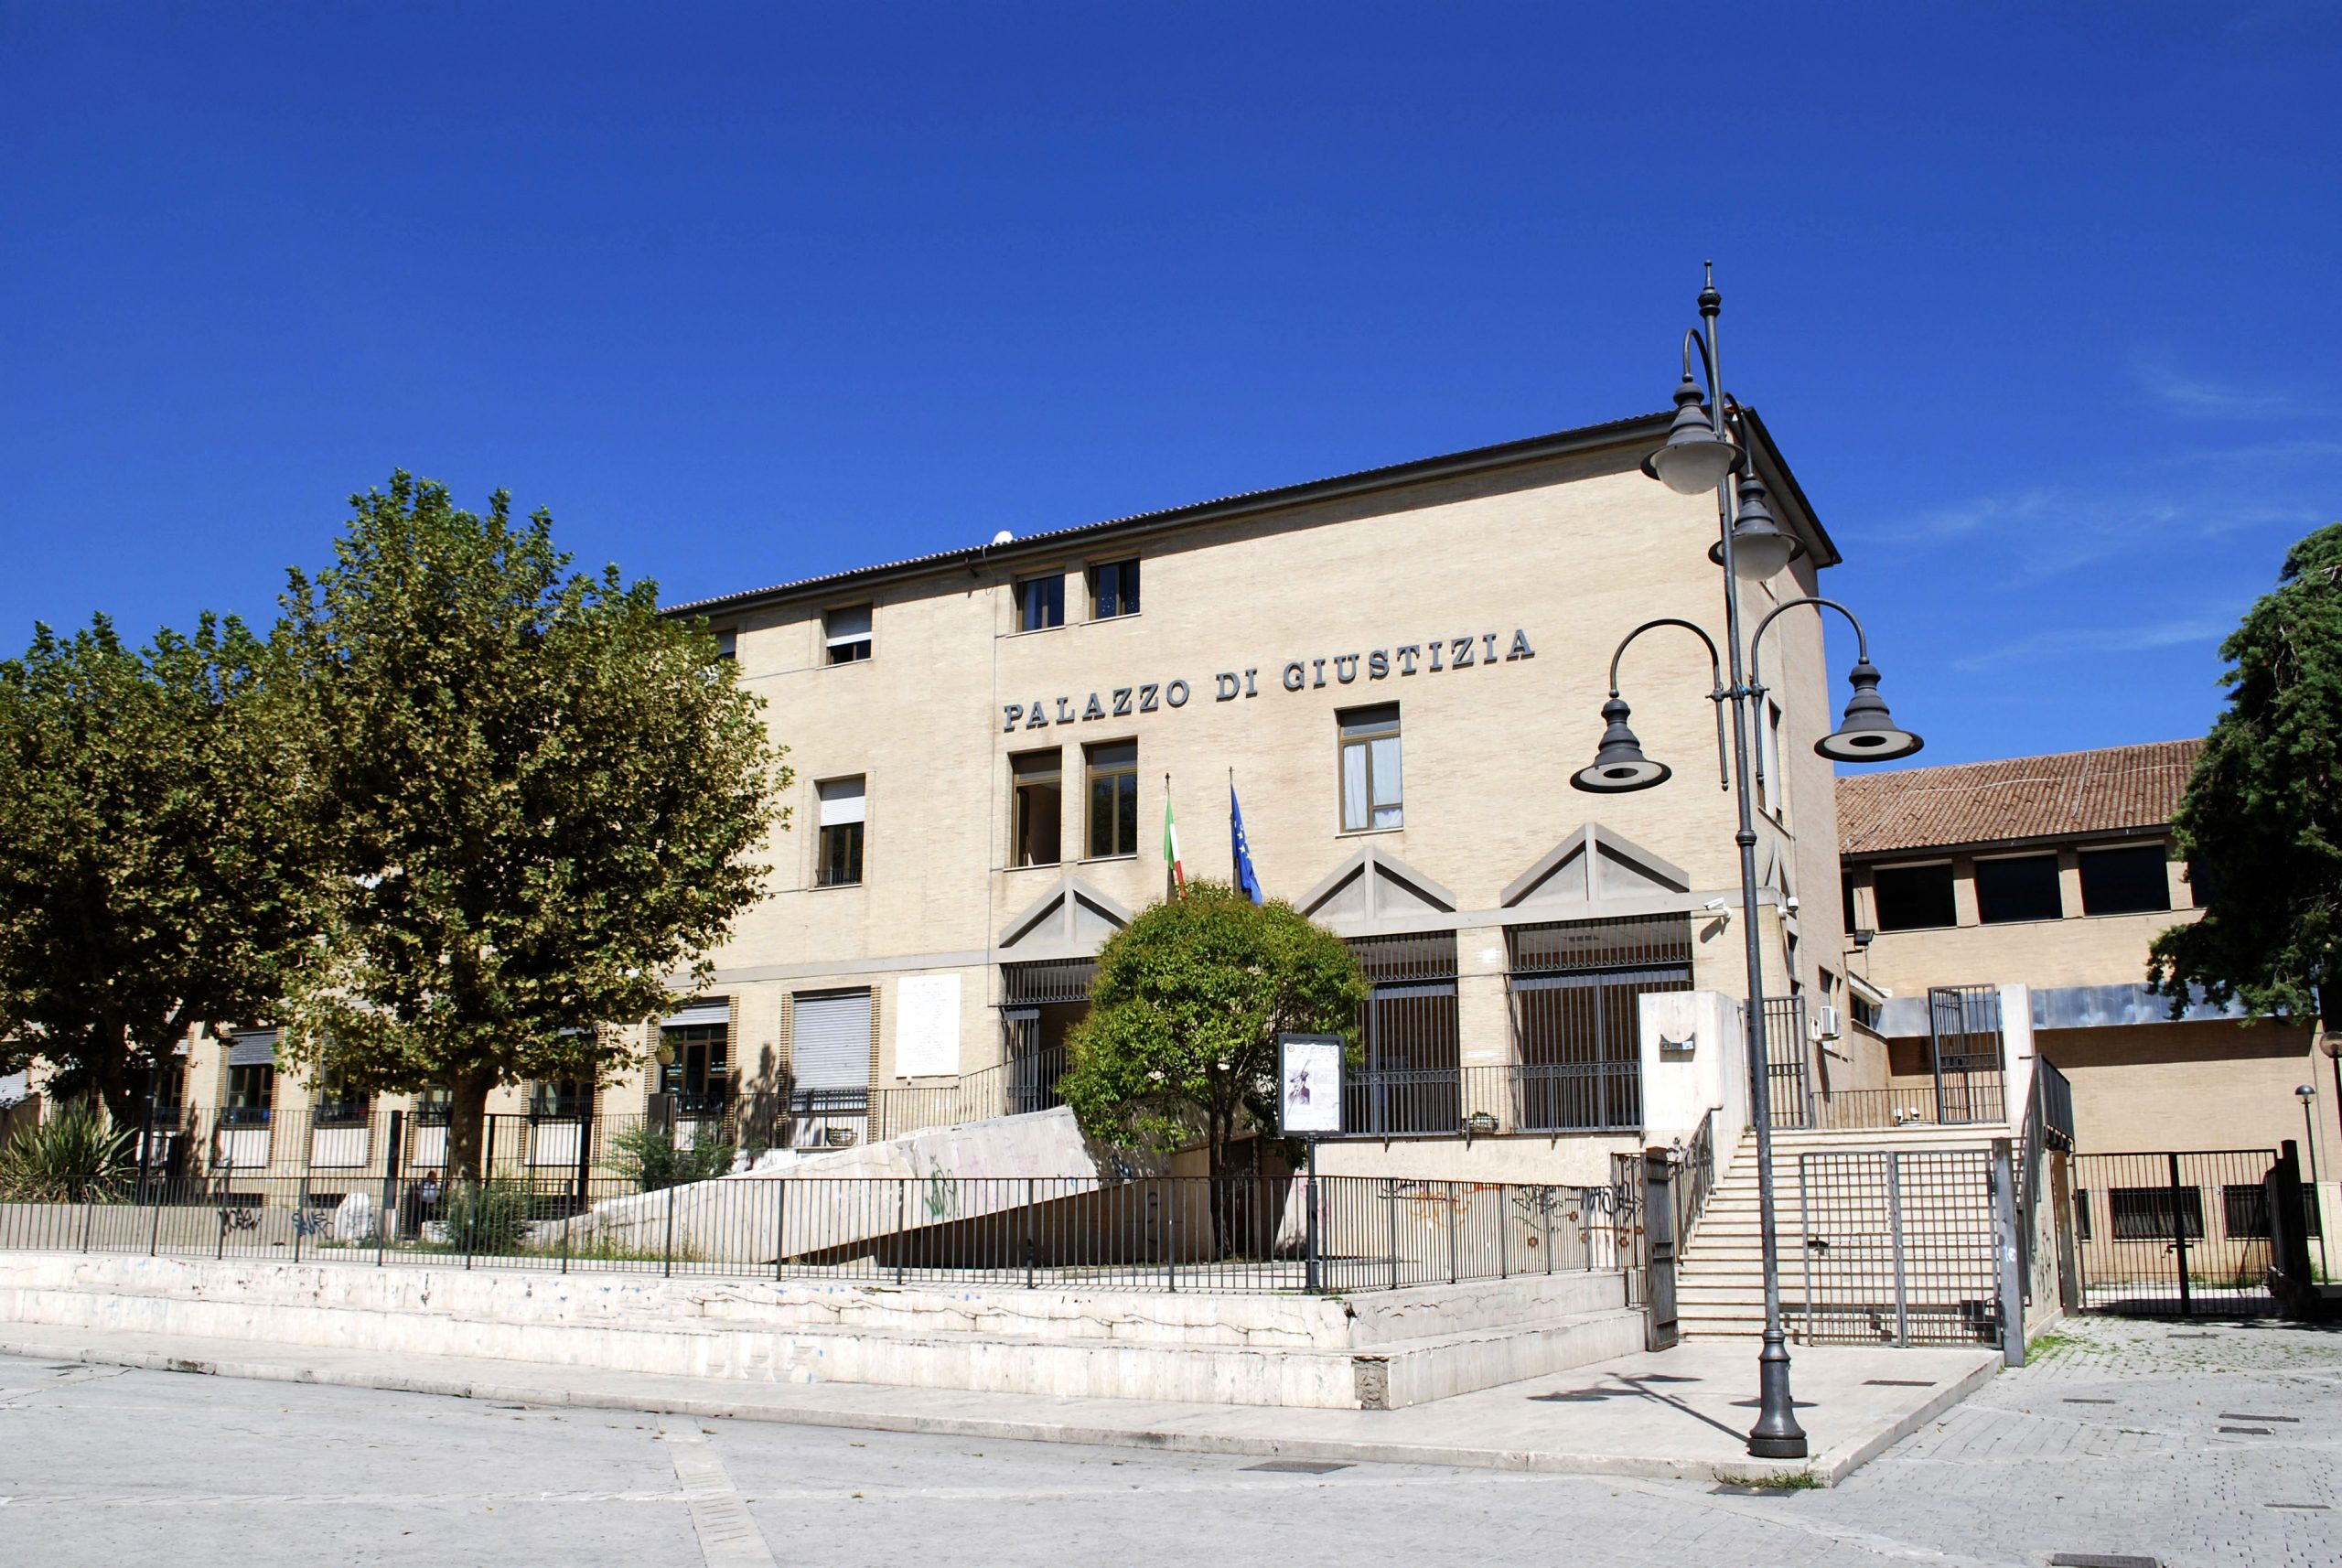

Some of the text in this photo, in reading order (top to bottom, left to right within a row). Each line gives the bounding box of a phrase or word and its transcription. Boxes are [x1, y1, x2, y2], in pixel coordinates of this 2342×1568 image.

[1004, 629, 1535, 733] PALAZZO DI GIUSTIZIA
